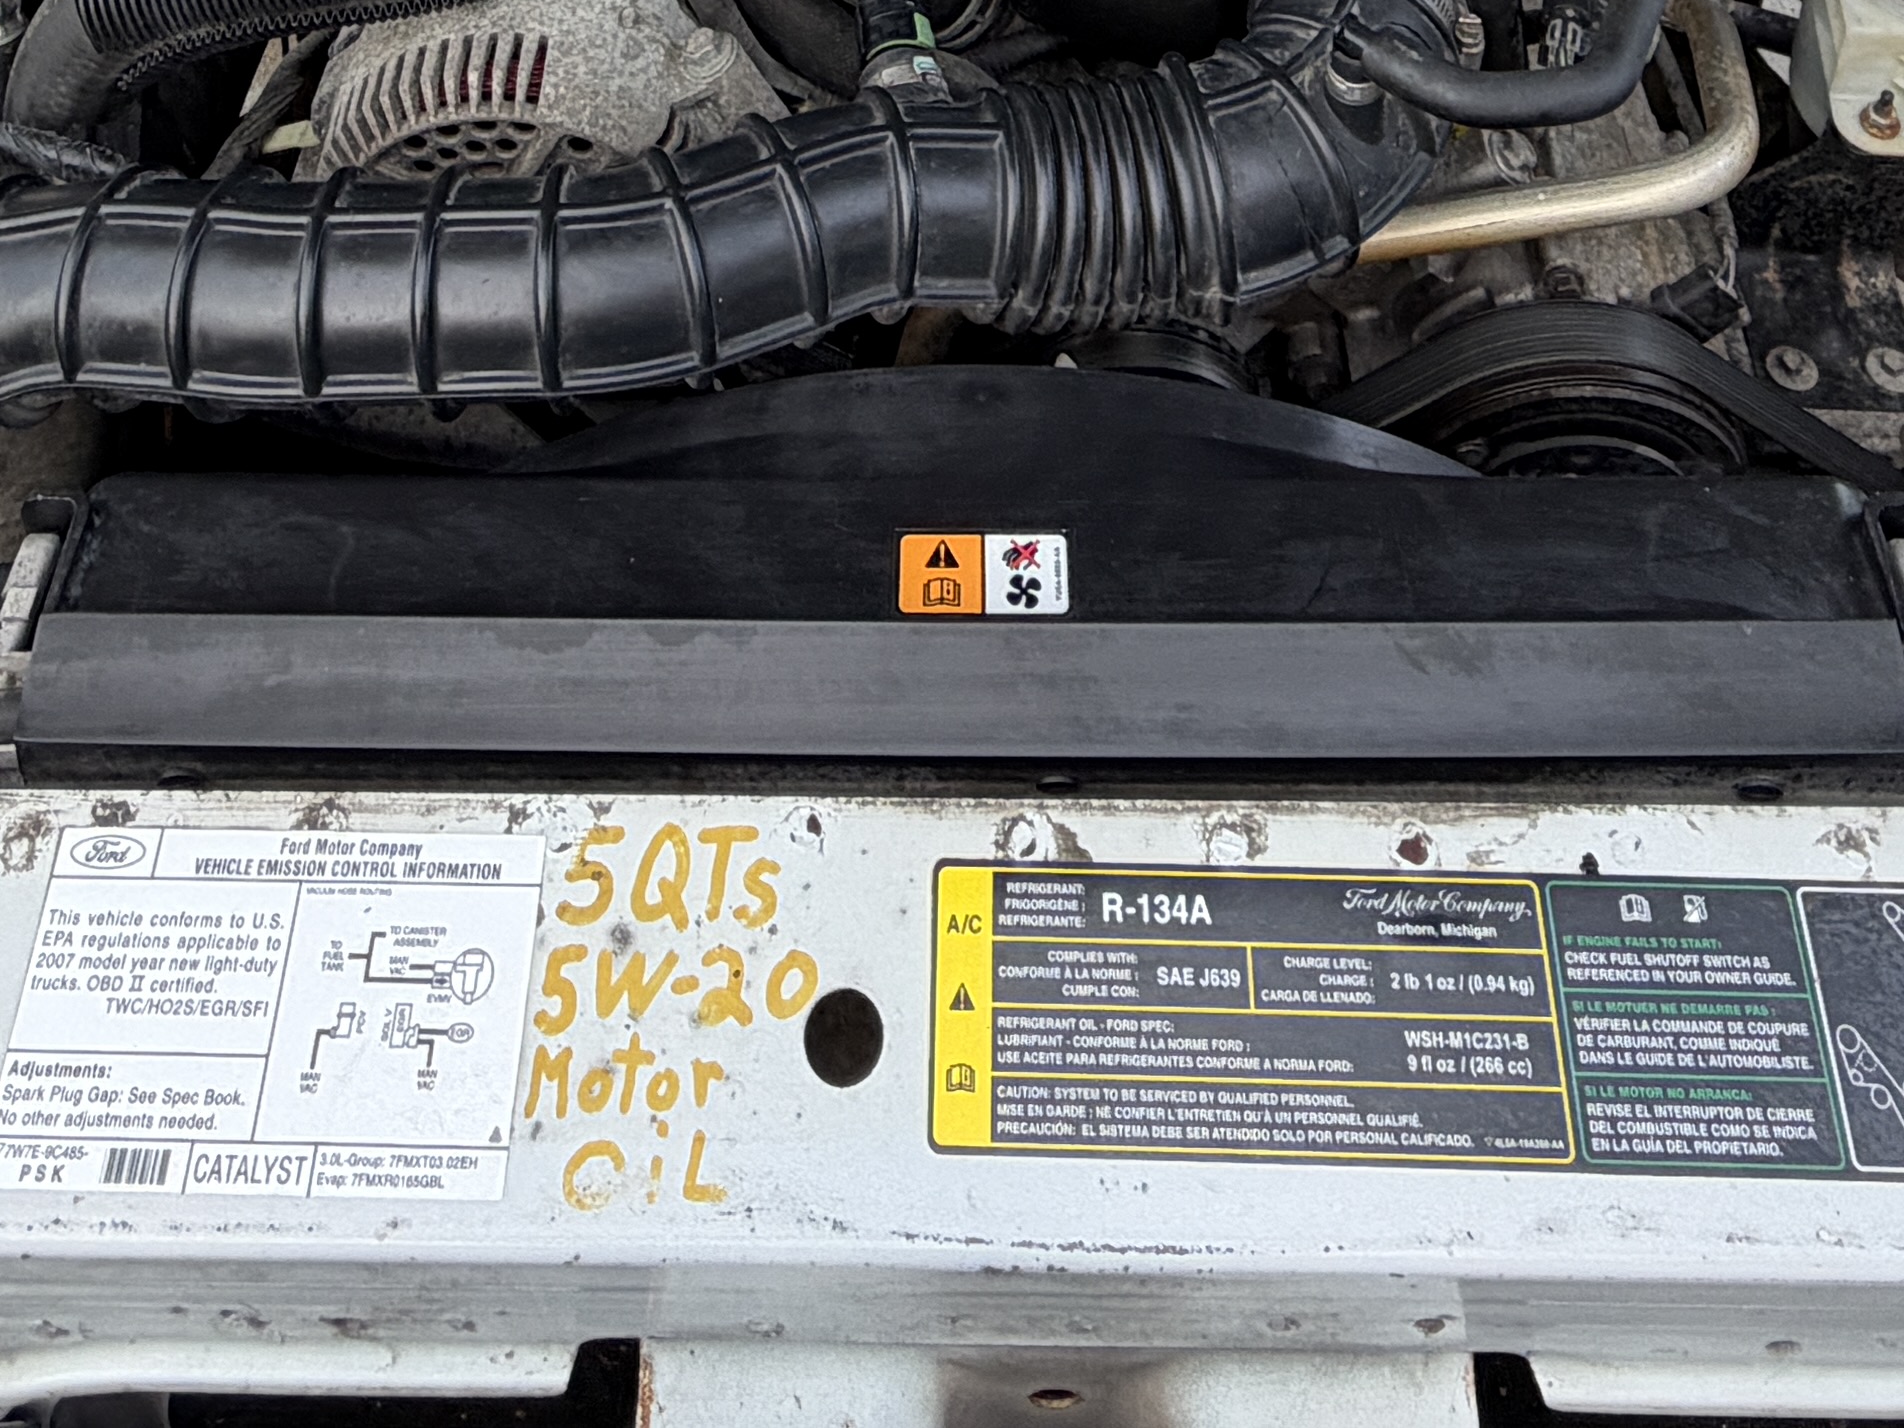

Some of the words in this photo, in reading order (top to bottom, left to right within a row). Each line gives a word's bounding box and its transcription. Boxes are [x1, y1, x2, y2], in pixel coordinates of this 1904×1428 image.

[280, 837, 310, 856] Ford
[315, 838, 355, 857] Motor
[360, 840, 422, 860] Company
[195, 857, 253, 877] VEHICLE
[257, 859, 327, 878] EMISSION
[331, 860, 398, 879] CONTROL
[402, 862, 502, 881] INFORMATION
[1006, 882, 1086, 895] REFRIGERANT:
[1102, 892, 1213, 925] R-134A
[1343, 888, 1388, 911] Ford
[1382, 888, 1439, 918] Motor
[1439, 890, 1532, 922] Company
[49, 908, 80, 926] This
[88, 910, 143, 926] vehicle
[150, 911, 222, 928] conforms
[230, 913, 244, 929] to
[252, 913, 285, 930] U.S.
[946, 914, 983, 934] A/C
[1377, 921, 1438, 938] Dearborn,
[1441, 923, 1497, 940] Michigan
[42, 930, 73, 946] EPA
[81, 931, 170, 951] regulations
[177, 934, 259, 954] applicable
[266, 936, 282, 951] to
[330, 940, 342, 949] TO
[36, 953, 76, 968] 2007
[78, 954, 127, 970] model
[130, 956, 166, 974] year
[169, 958, 200, 971] new
[204, 956, 278, 976] light-duty
[1048, 950, 1104, 963] COMPLIES
[1283, 956, 1331, 969] CHARGE
[1333, 958, 1372, 970] LEVEL:
[1564, 951, 1607, 965] CHECK
[1610, 952, 1642, 967] FUEL
[1644, 953, 1700, 968] SHUTOFF
[1703, 955, 1750, 969] SWITCH
[1753, 956, 1771, 969] AS
[31, 974, 82, 991] trucks.
[86, 975, 124, 992] OBD
[150, 976, 218, 994] certified.
[1156, 967, 1194, 986] SAE
[1199, 968, 1241, 988] J639
[1390, 973, 1400, 989] 2
[1404, 973, 1420, 990] lb
[1426, 974, 1433, 990] 1
[1436, 978, 1455, 991] oz
[1510, 975, 1535, 996] kg)
[1567, 968, 1650, 982] REFERENCED
[1652, 970, 1666, 983] IN
[1667, 971, 1703, 984] YOUR
[1705, 972, 1752, 985] OWNER
[533, 943, 819, 1036] 5W-20
[1261, 989, 1300, 1002] CARGA
[1302, 990, 1318, 1002] DE
[106, 998, 269, 1017] TWC/HO2S/EGR/SFI
[997, 1016, 1076, 1030] REFRIGERANT
[1106, 1019, 1138, 1032] FORD
[1404, 1030, 1530, 1050] WSH-M1C231-B
[8, 1060, 112, 1081] Adjustments:
[524, 1031, 725, 1120] Motor
[1407, 1054, 1417, 1072] 9
[1421, 1055, 1432, 1073] fl
[1436, 1059, 1456, 1073] oz
[1470, 1057, 1505, 1078] (266
[1508, 1058, 1533, 1078] cc)
[2, 1084, 45, 1102] Spark
[49, 1086, 82, 1106] Plug
[88, 1086, 122, 1106] Gap:
[128, 1087, 157, 1104] See
[162, 1088, 199, 1107] Spec
[203, 1089, 245, 1106] Book.
[1054, 1087, 1101, 1101] SYSTEM
[1103, 1088, 1118, 1101] TO
[1122, 1088, 1136, 1102] BE
[1139, 1089, 1196, 1103] SERVICED
[1199, 1091, 1215, 1104] BY
[1218, 1092, 1279, 1106] QUALIFIED
[21, 1110, 60, 1127] other
[64, 1110, 154, 1131] adjustments
[159, 1113, 217, 1130] needed.
[1589, 1120, 1615, 1134] DEL
[1617, 1121, 1709, 1137] COMBUSTIBLE
[1711, 1124, 1751, 1138] COMO
[1753, 1125, 1770, 1138] SE
[1773, 1126, 1817, 1140] INDICA
[193, 1154, 308, 1185] CATALYST
[317, 1174, 348, 1188] Evap:
